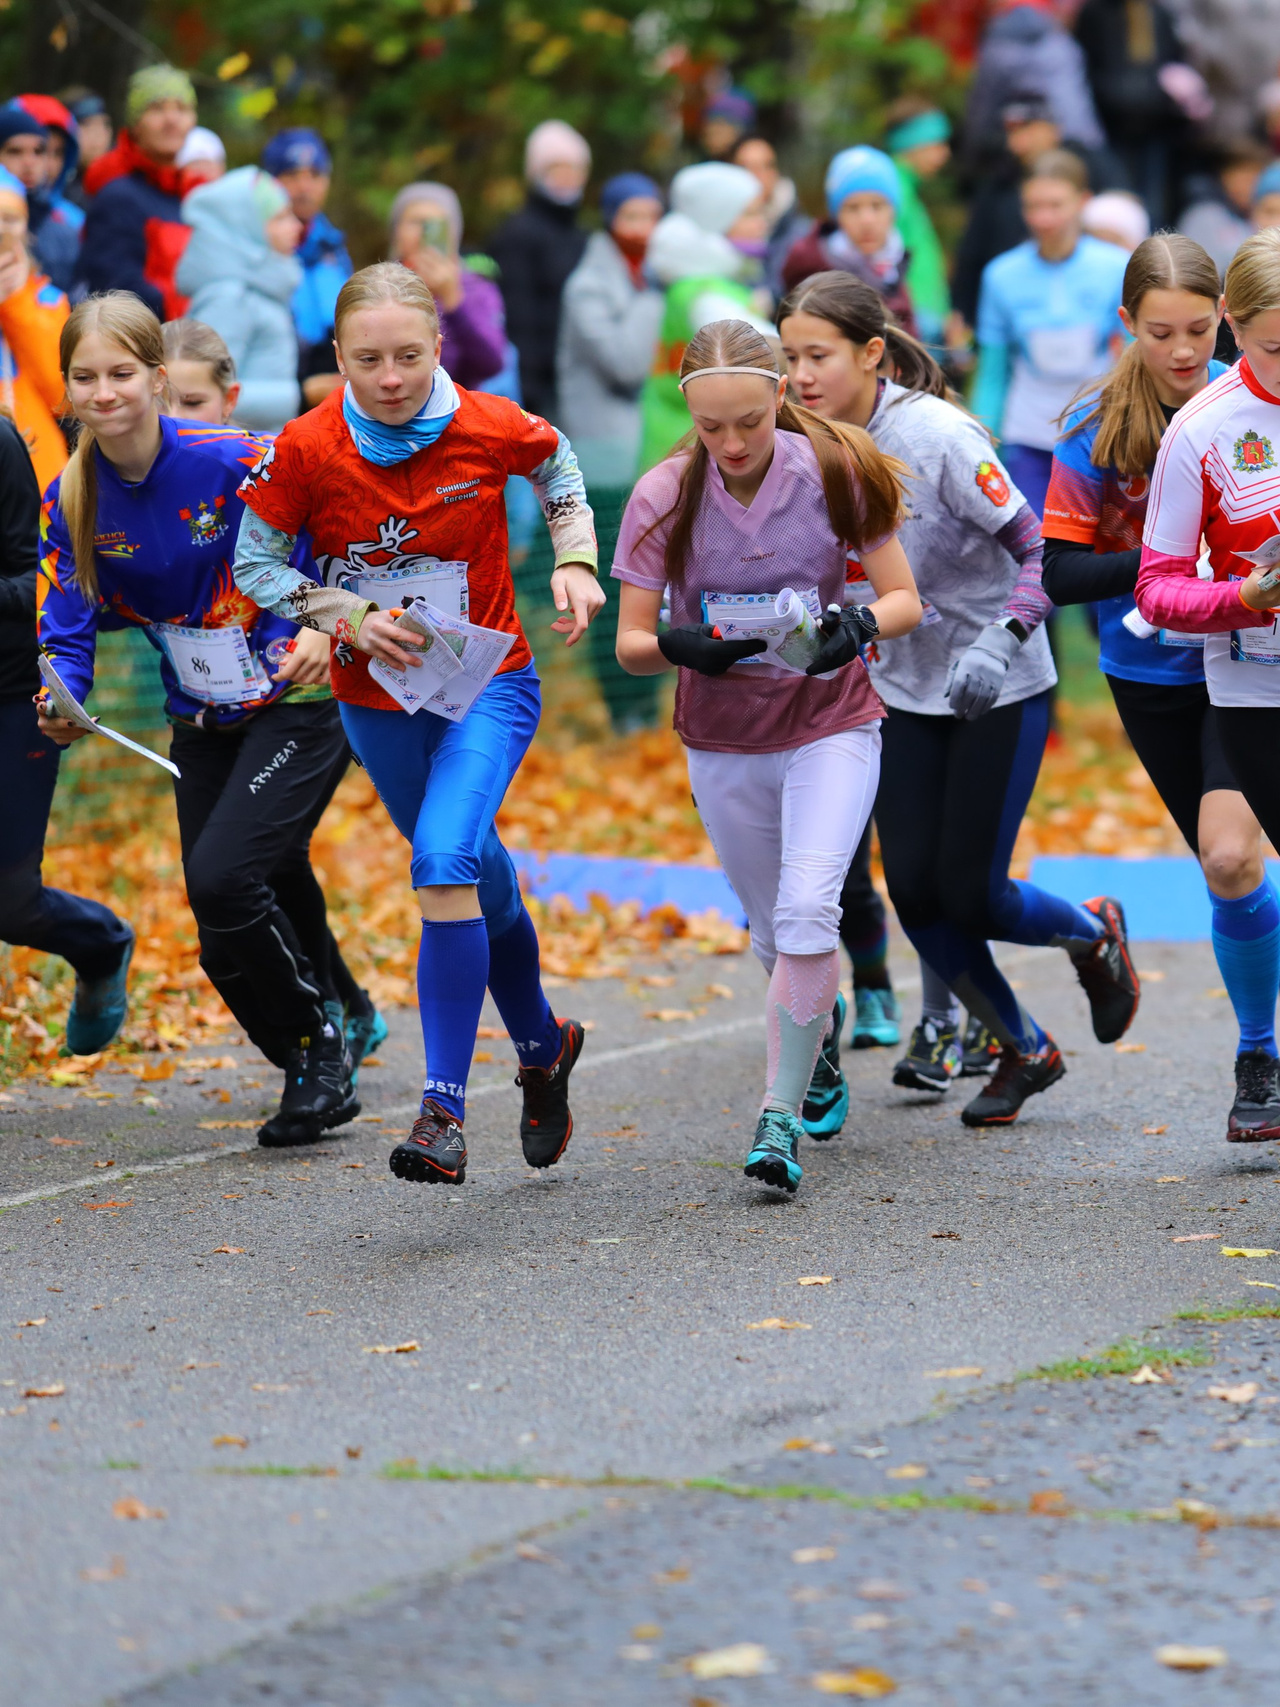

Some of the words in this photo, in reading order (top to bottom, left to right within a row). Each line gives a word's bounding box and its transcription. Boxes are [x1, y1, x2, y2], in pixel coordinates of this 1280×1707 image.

[436, 478, 480, 495] Синицына
[444, 490, 479, 504] Евгения
[191, 656, 211, 676] 86
